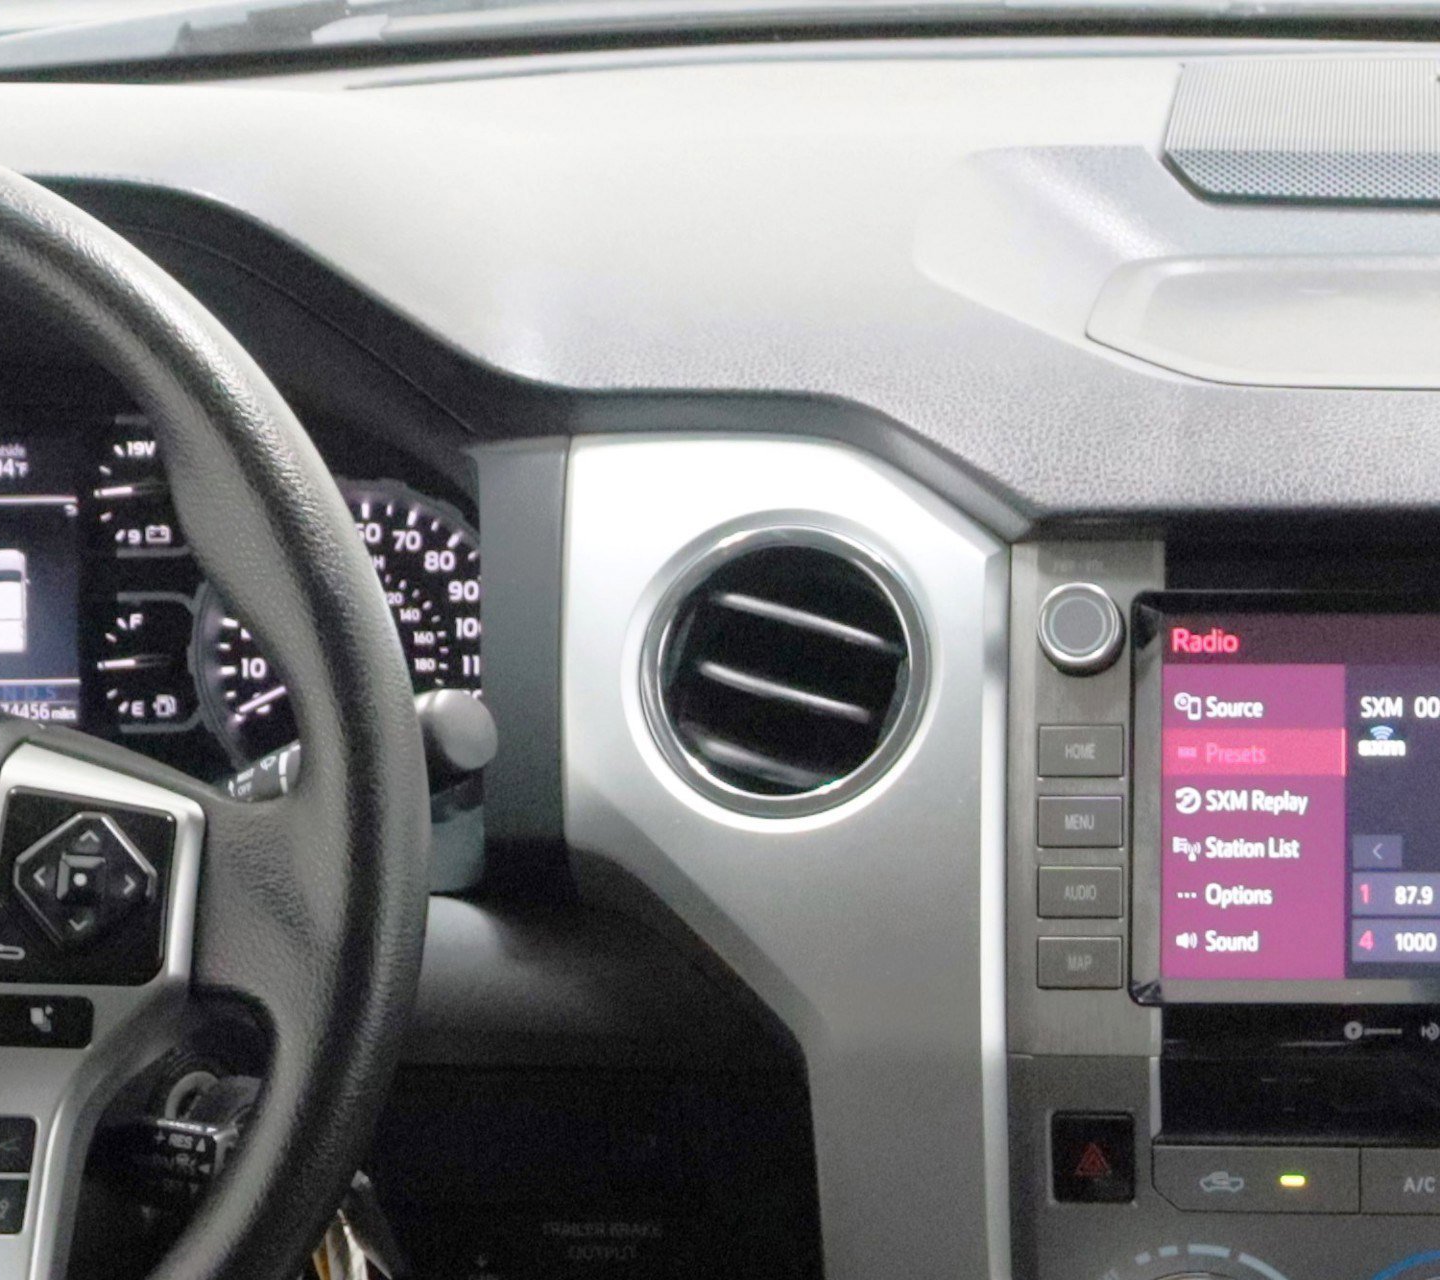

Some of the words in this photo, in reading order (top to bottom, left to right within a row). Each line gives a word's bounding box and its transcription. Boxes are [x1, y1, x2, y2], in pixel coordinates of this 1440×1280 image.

[126, 441, 156, 456] 19V
[392, 530, 422, 551] 70
[424, 551, 455, 571] 80
[387, 592, 404, 605] 20
[448, 581, 479, 601] 90
[129, 614, 143, 629] F
[400, 608, 421, 622] 140
[413, 631, 435, 645] 160
[455, 618, 481, 638] 10
[1172, 628, 1239, 653] Radio
[241, 657, 267, 679] 10
[414, 658, 435, 671] 180
[131, 701, 144, 716] E
[1205, 696, 1263, 718] Source
[1360, 697, 1403, 718] SXM
[1065, 743, 1096, 760] HOME
[1205, 741, 1266, 763] Presets
[1205, 790, 1247, 812] SXM
[1252, 790, 1308, 815] Replay
[1065, 814, 1095, 831] MENU
[1205, 837, 1264, 859] Station
[1268, 837, 1300, 859] List
[1064, 884, 1097, 901] AUDIO
[1205, 883, 1273, 909] Options
[1360, 884, 1370, 904] 1
[1394, 886, 1434, 905] 87.9
[1205, 930, 1259, 952] Sound
[1359, 930, 1374, 949] 4
[1394, 933, 1437, 952] 1000
[1068, 955, 1093, 972] MAP
[1403, 1175, 1436, 1194] A/C
